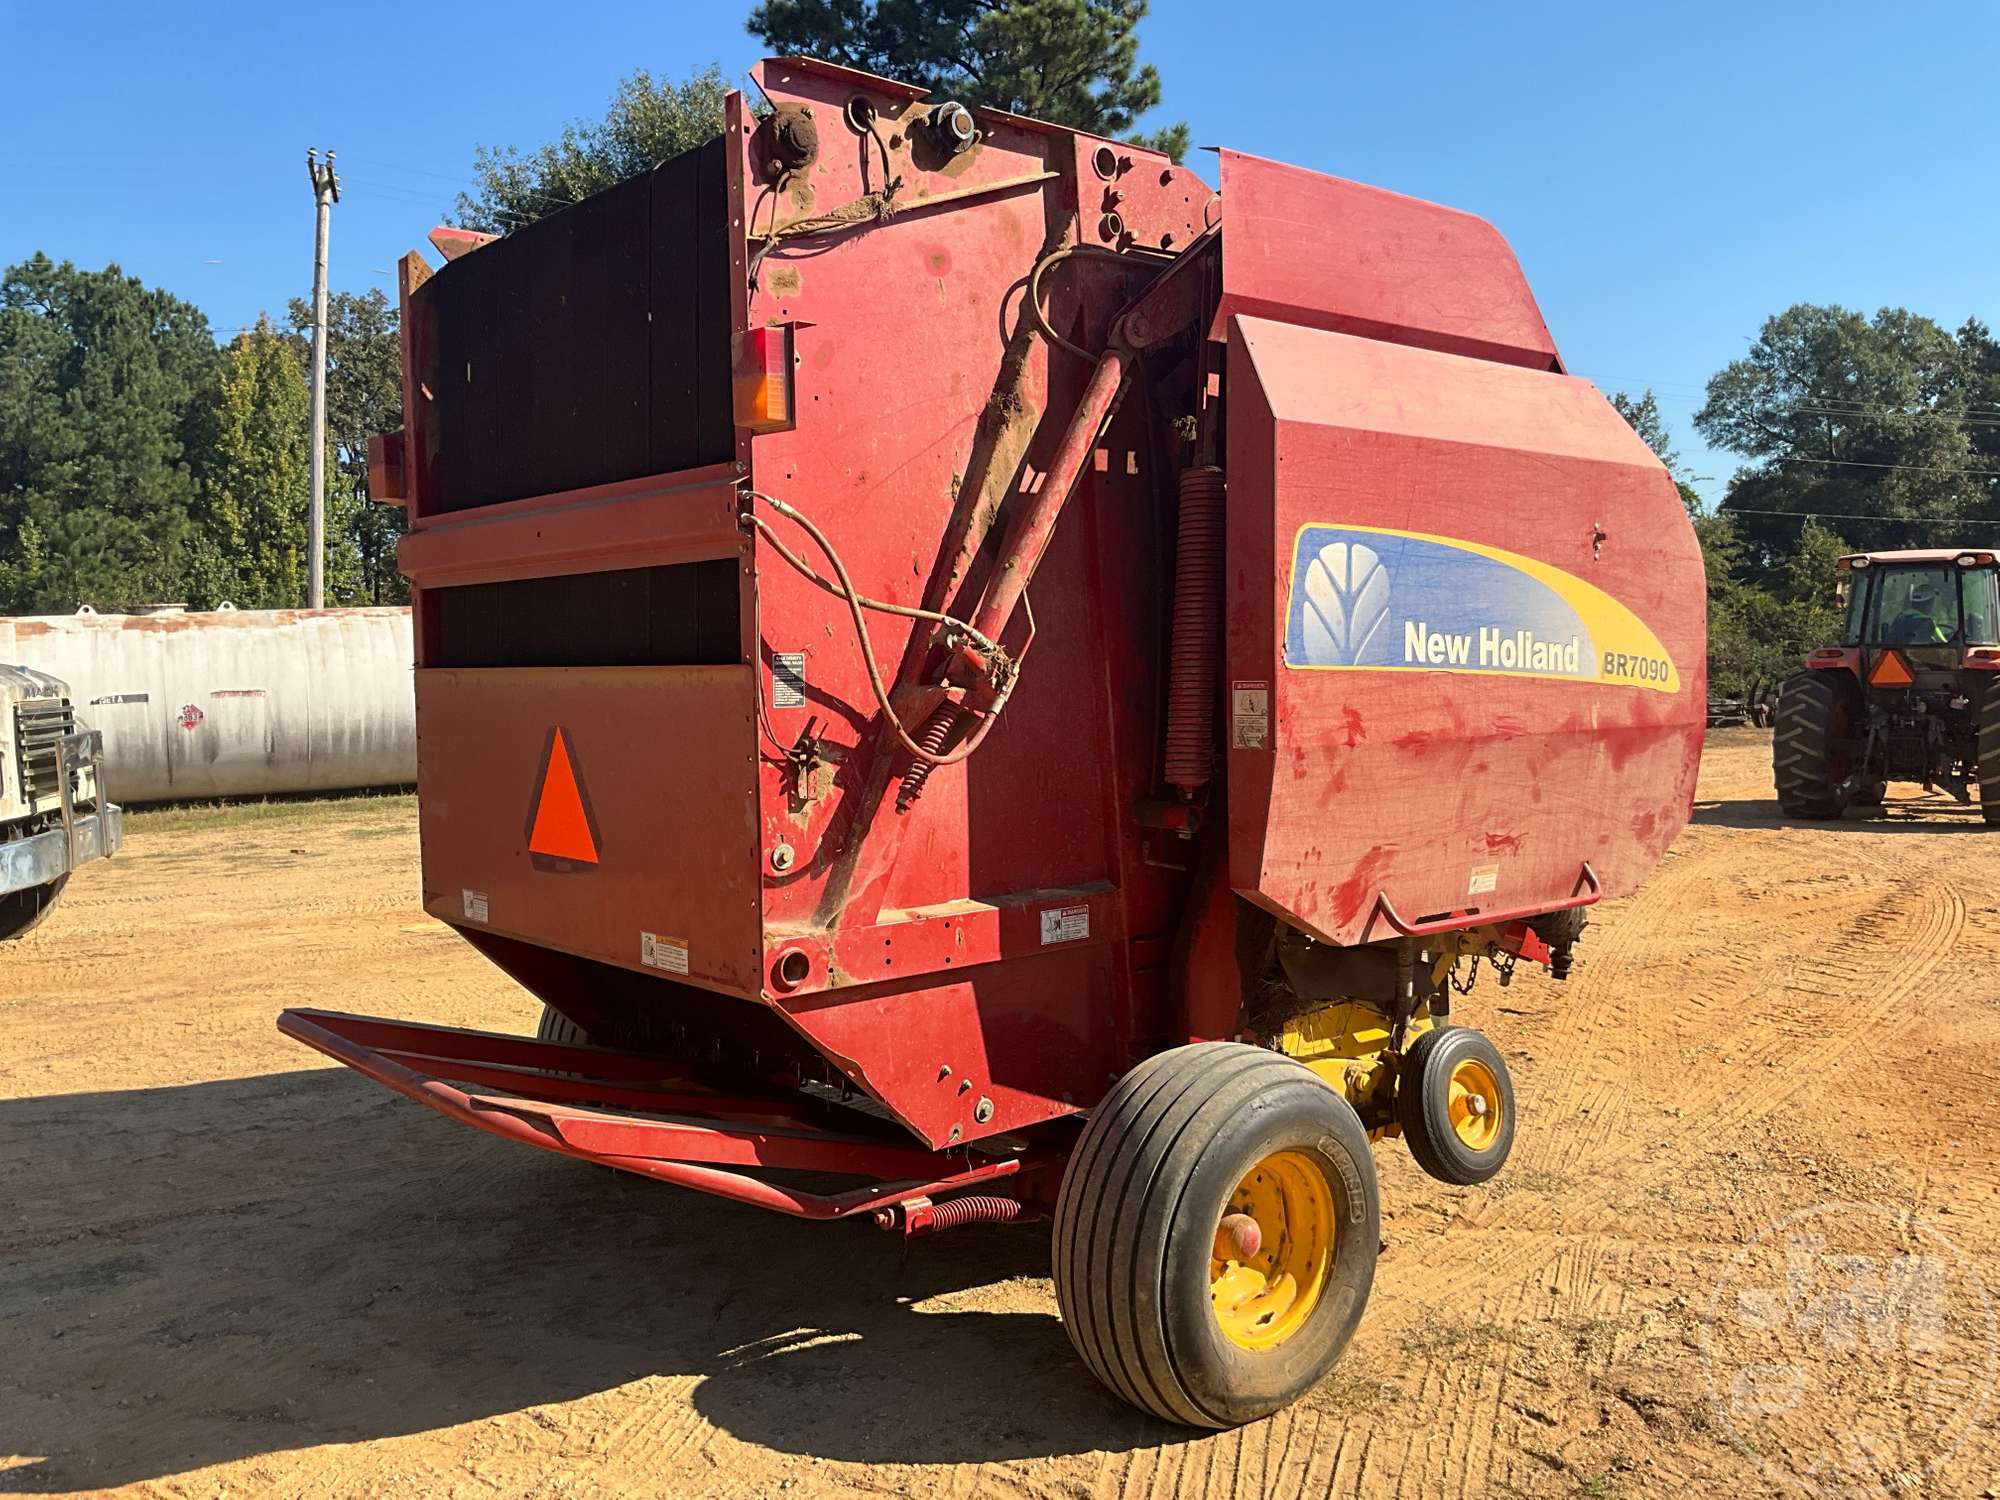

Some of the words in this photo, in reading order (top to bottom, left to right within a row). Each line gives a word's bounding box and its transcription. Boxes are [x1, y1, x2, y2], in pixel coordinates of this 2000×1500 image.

[1404, 620, 1472, 665] New
[1479, 626, 1579, 673] Holland
[1604, 651, 1669, 682] BR7090
